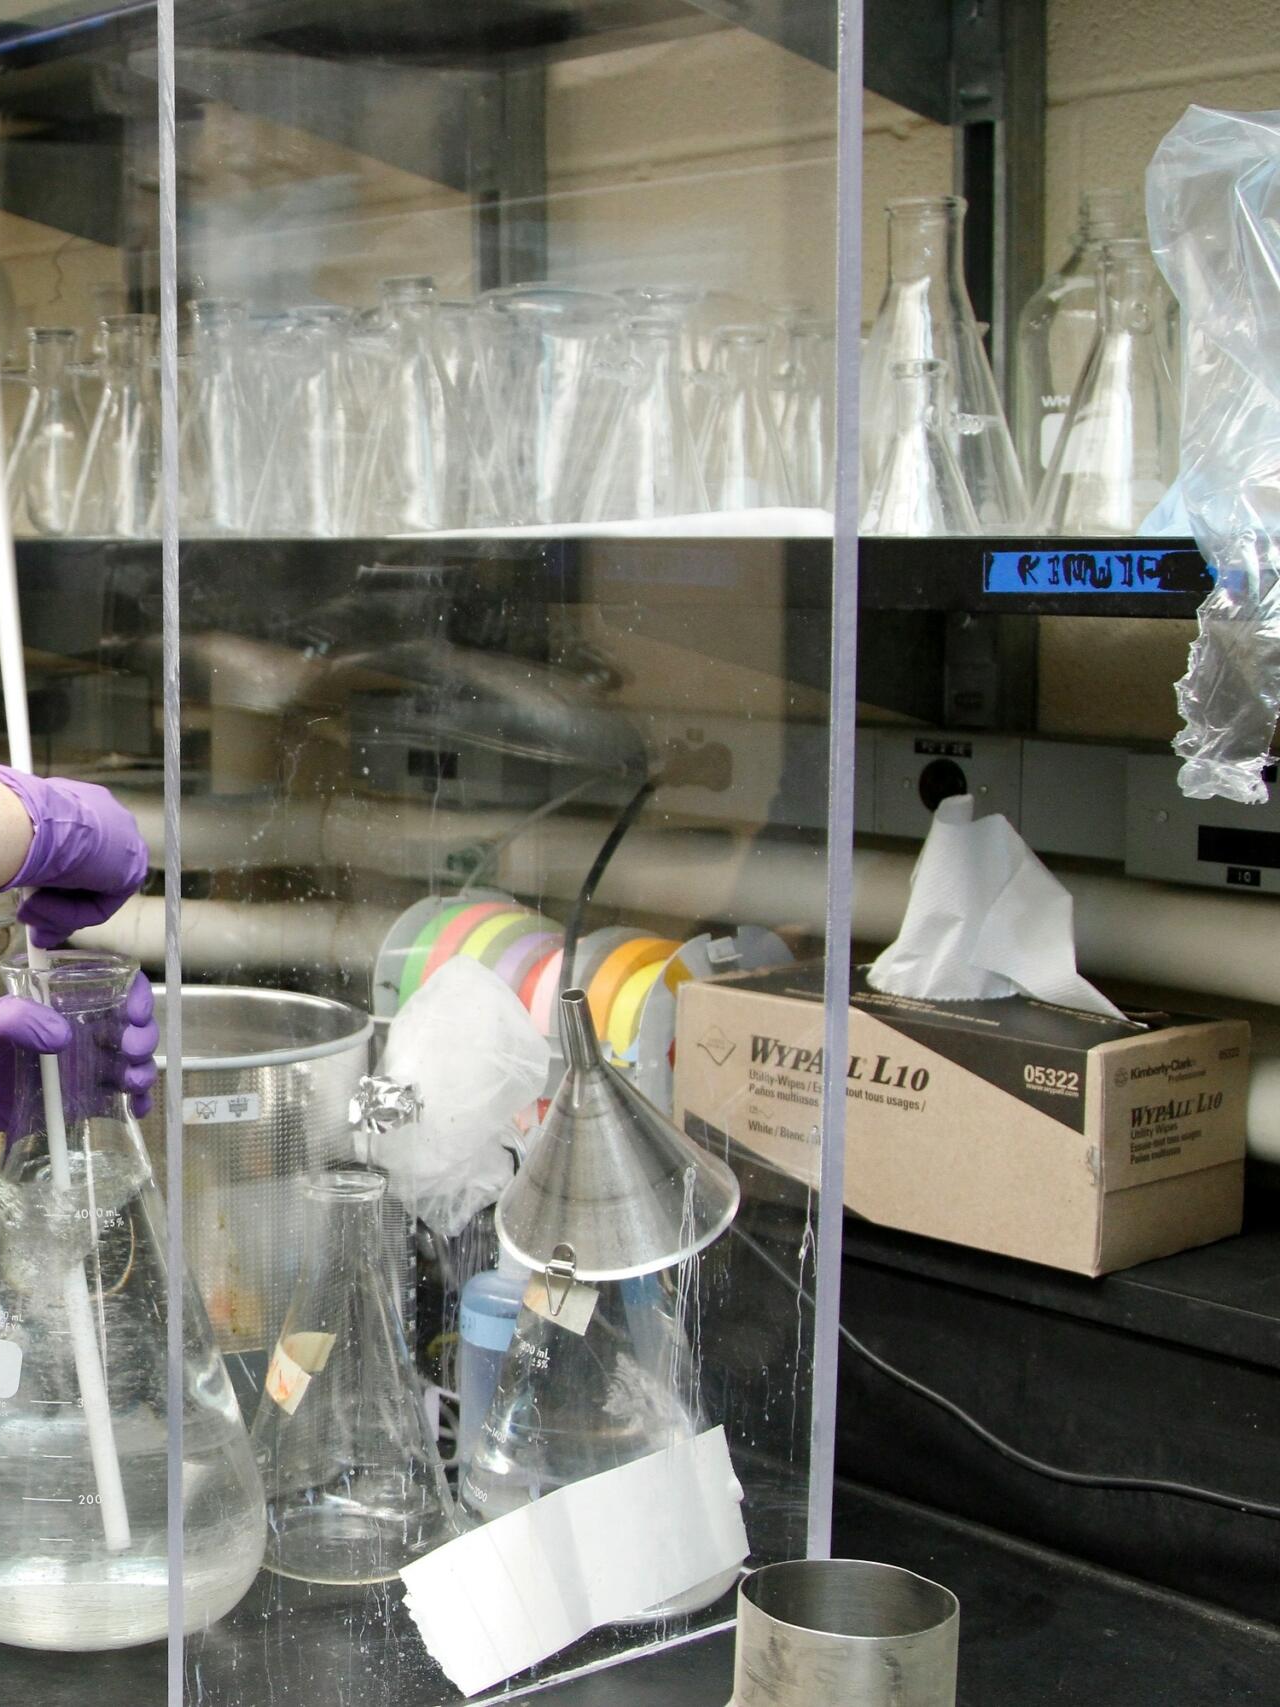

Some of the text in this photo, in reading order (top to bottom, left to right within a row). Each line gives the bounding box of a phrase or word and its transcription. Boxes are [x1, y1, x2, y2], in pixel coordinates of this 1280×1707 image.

[750, 1035, 930, 1092] WYPAL L10
[1024, 1064, 1079, 1090] 05322
[865, 1091, 885, 1104] tous
[887, 1096, 920, 1111] usages
[1197, 1092, 1223, 1113] L10
[748, 1120, 774, 1136] White
[780, 1126, 805, 1142] Blanc
[74, 1207, 121, 1219] 400 mL
[79, 1494, 102, 1505] 200
